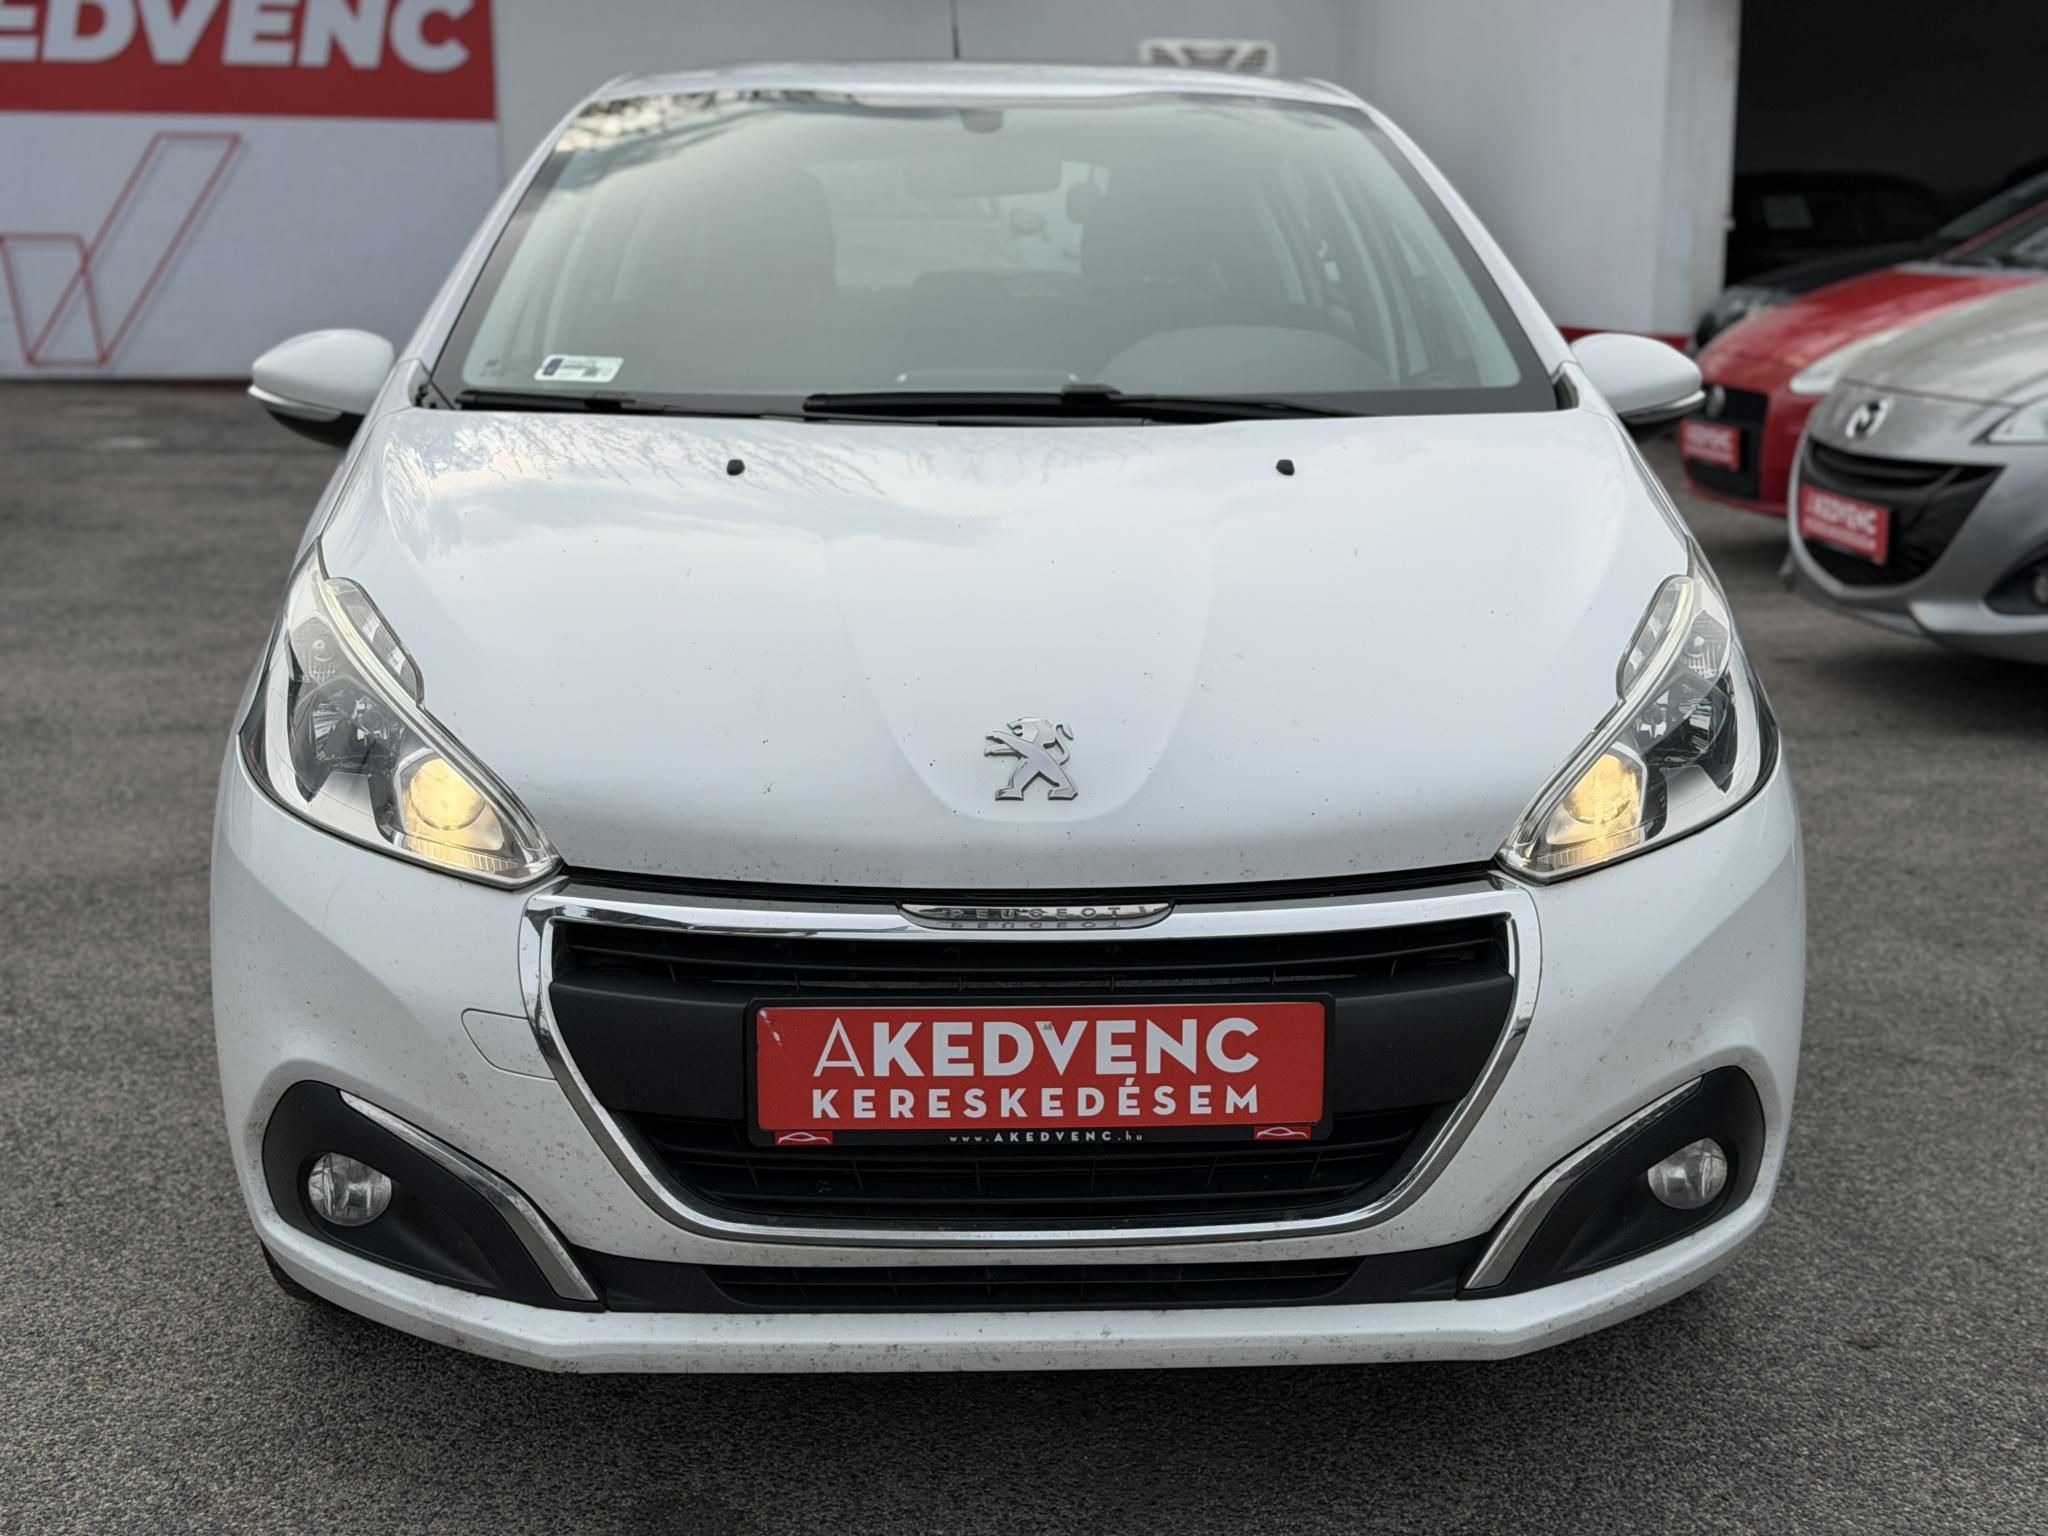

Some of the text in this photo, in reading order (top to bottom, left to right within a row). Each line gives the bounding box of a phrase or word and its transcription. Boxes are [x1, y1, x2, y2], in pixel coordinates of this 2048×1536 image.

[813, 1017, 1259, 1077] AKEDVENC
[812, 1078, 1258, 1119] KERESKEDÉSEM
[949, 1130, 1143, 1143] www.AKEDVENC.hu
